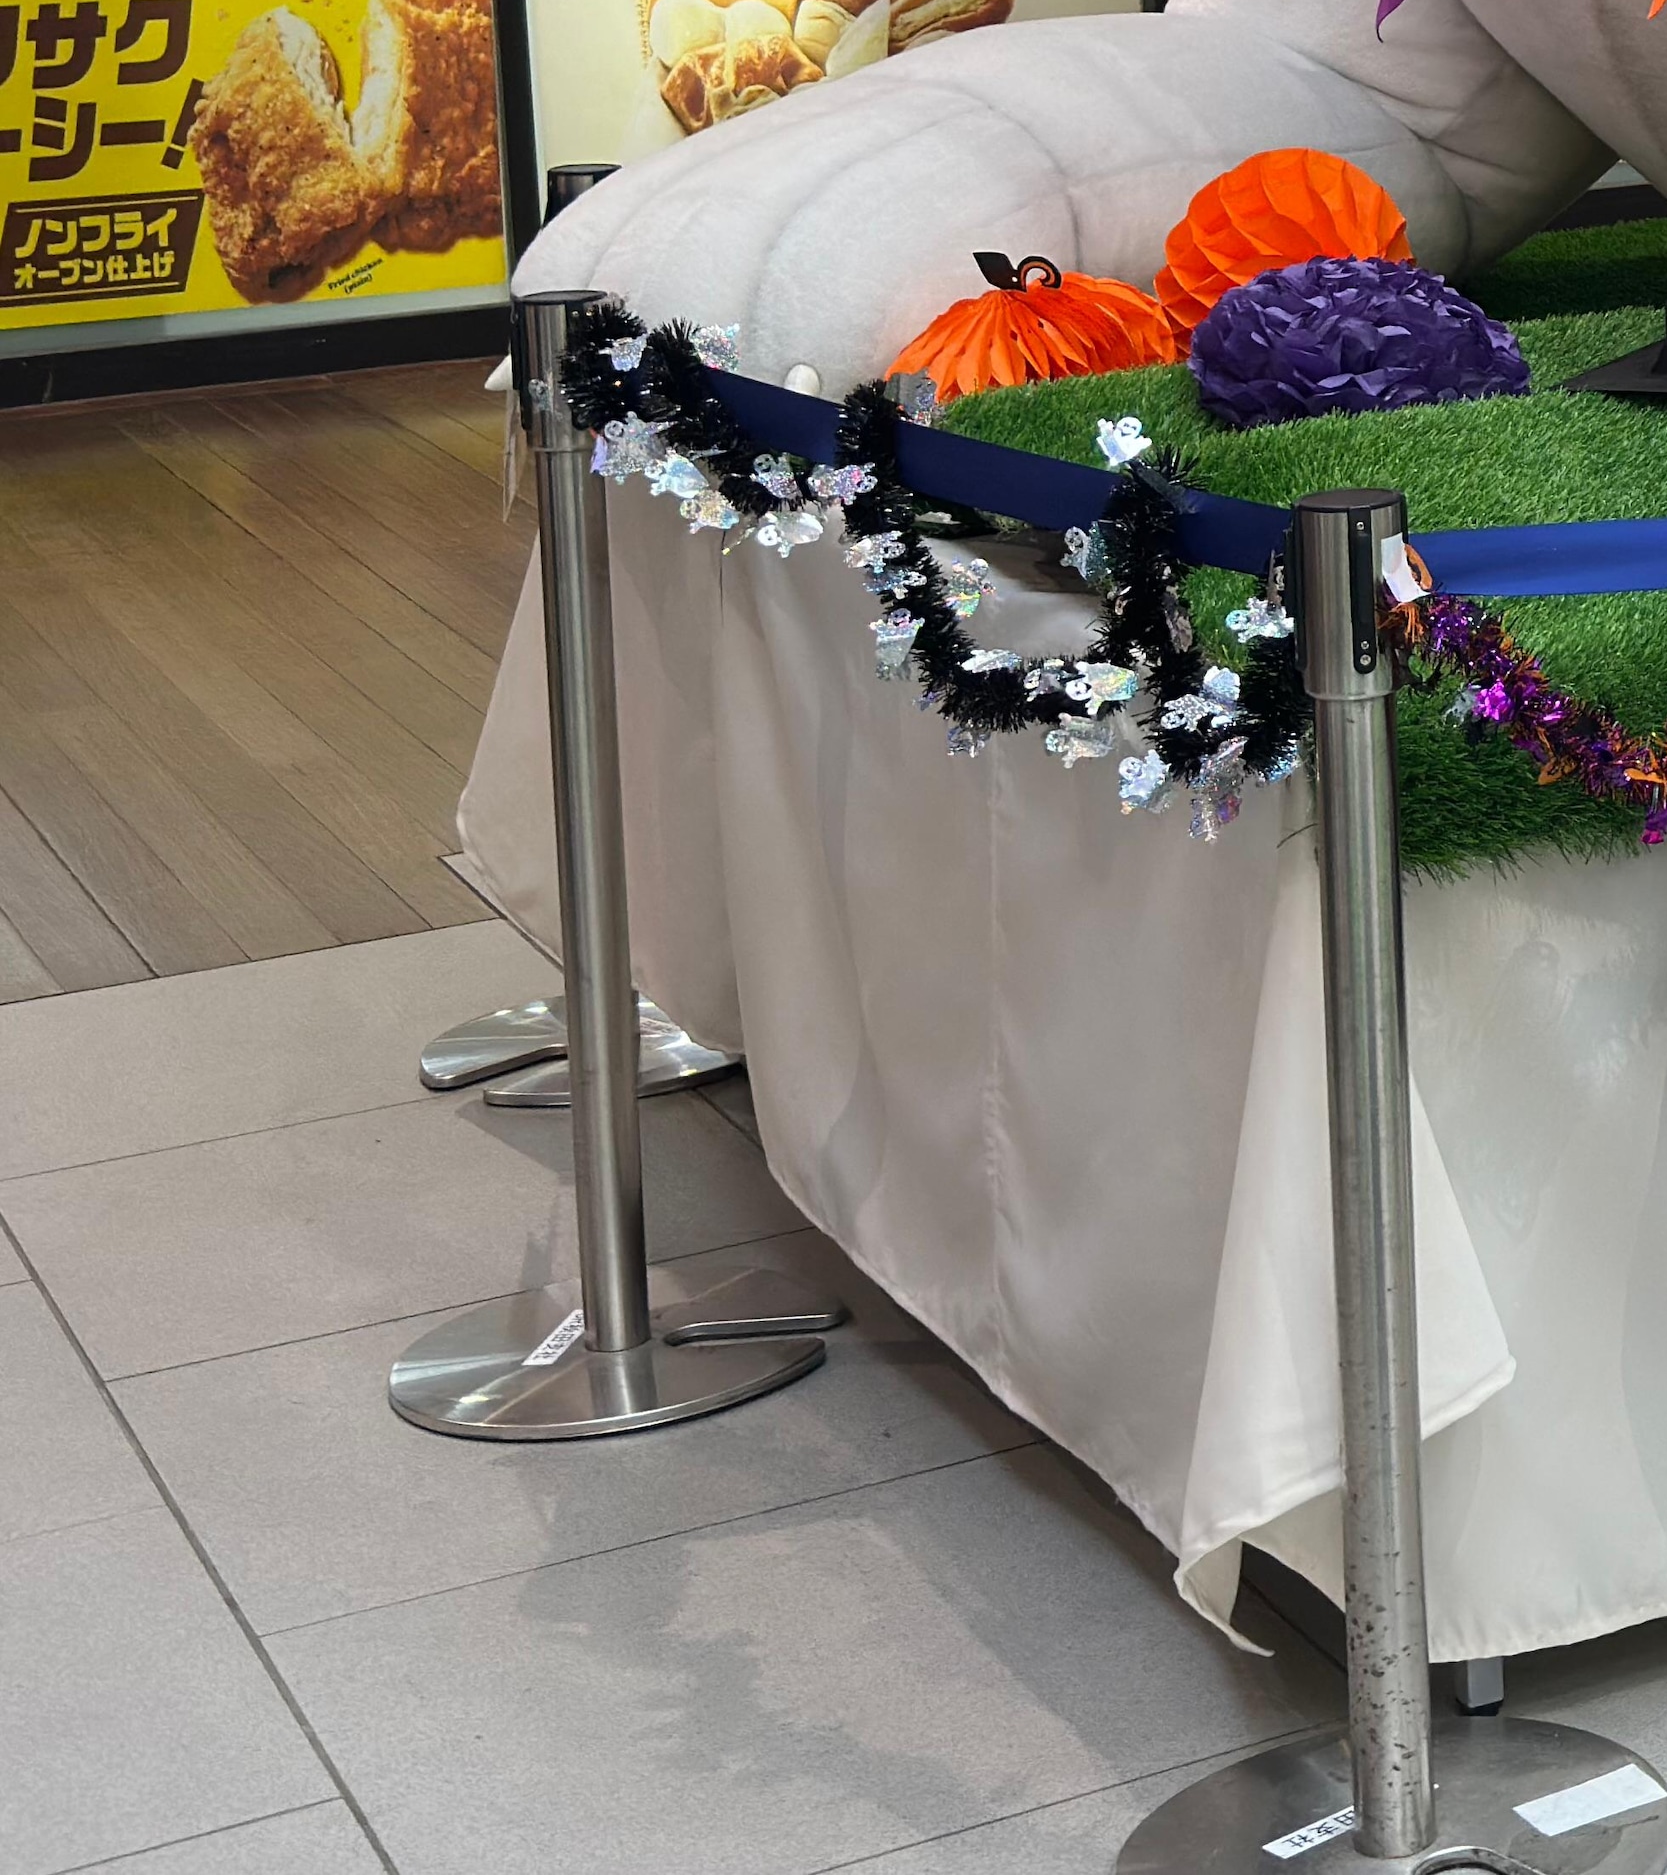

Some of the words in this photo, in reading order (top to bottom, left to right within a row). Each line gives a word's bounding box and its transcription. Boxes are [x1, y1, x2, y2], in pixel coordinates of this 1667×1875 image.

[14, 207, 177, 259] ノンフライ
[14, 250, 176, 290] オープン仕上げ
